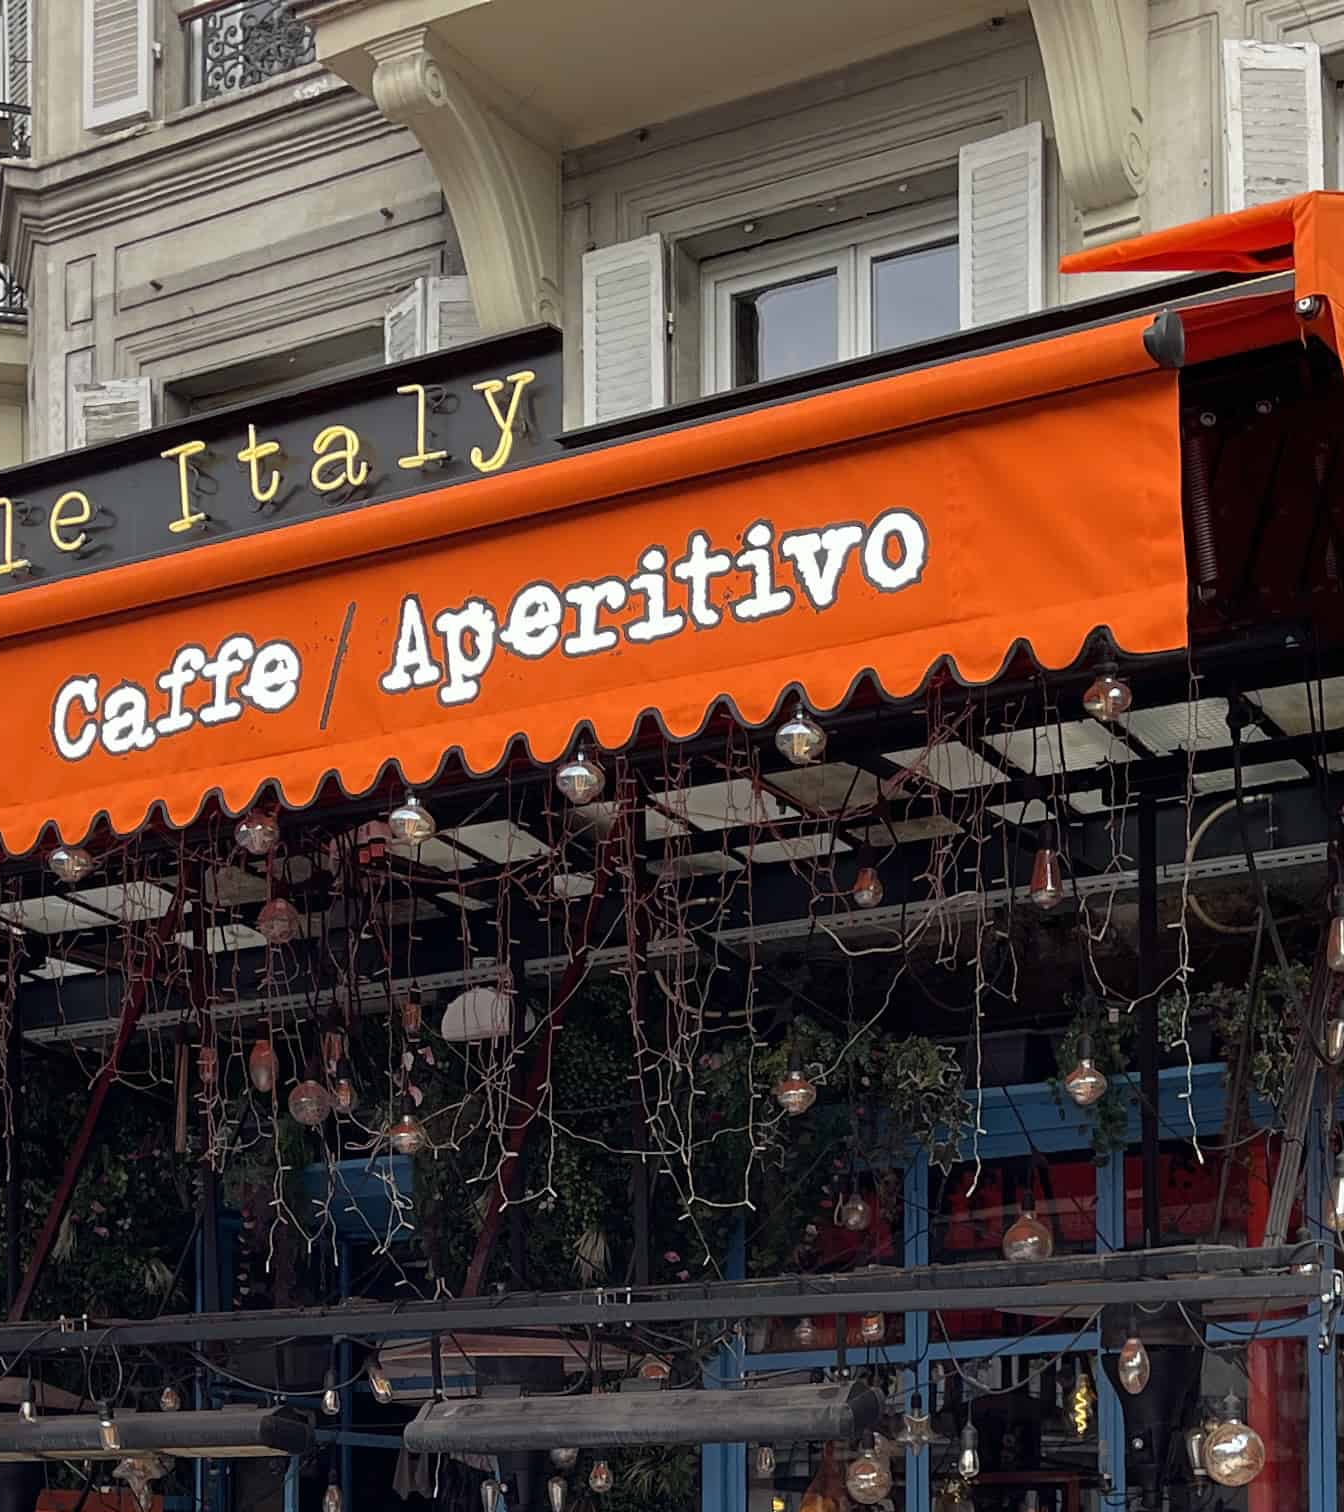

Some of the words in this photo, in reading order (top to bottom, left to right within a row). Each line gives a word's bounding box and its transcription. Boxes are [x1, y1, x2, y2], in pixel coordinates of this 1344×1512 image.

[164, 369, 536, 534] Italy
[52, 636, 303, 762] Caffe
[378, 508, 929, 706] Aperitivo
